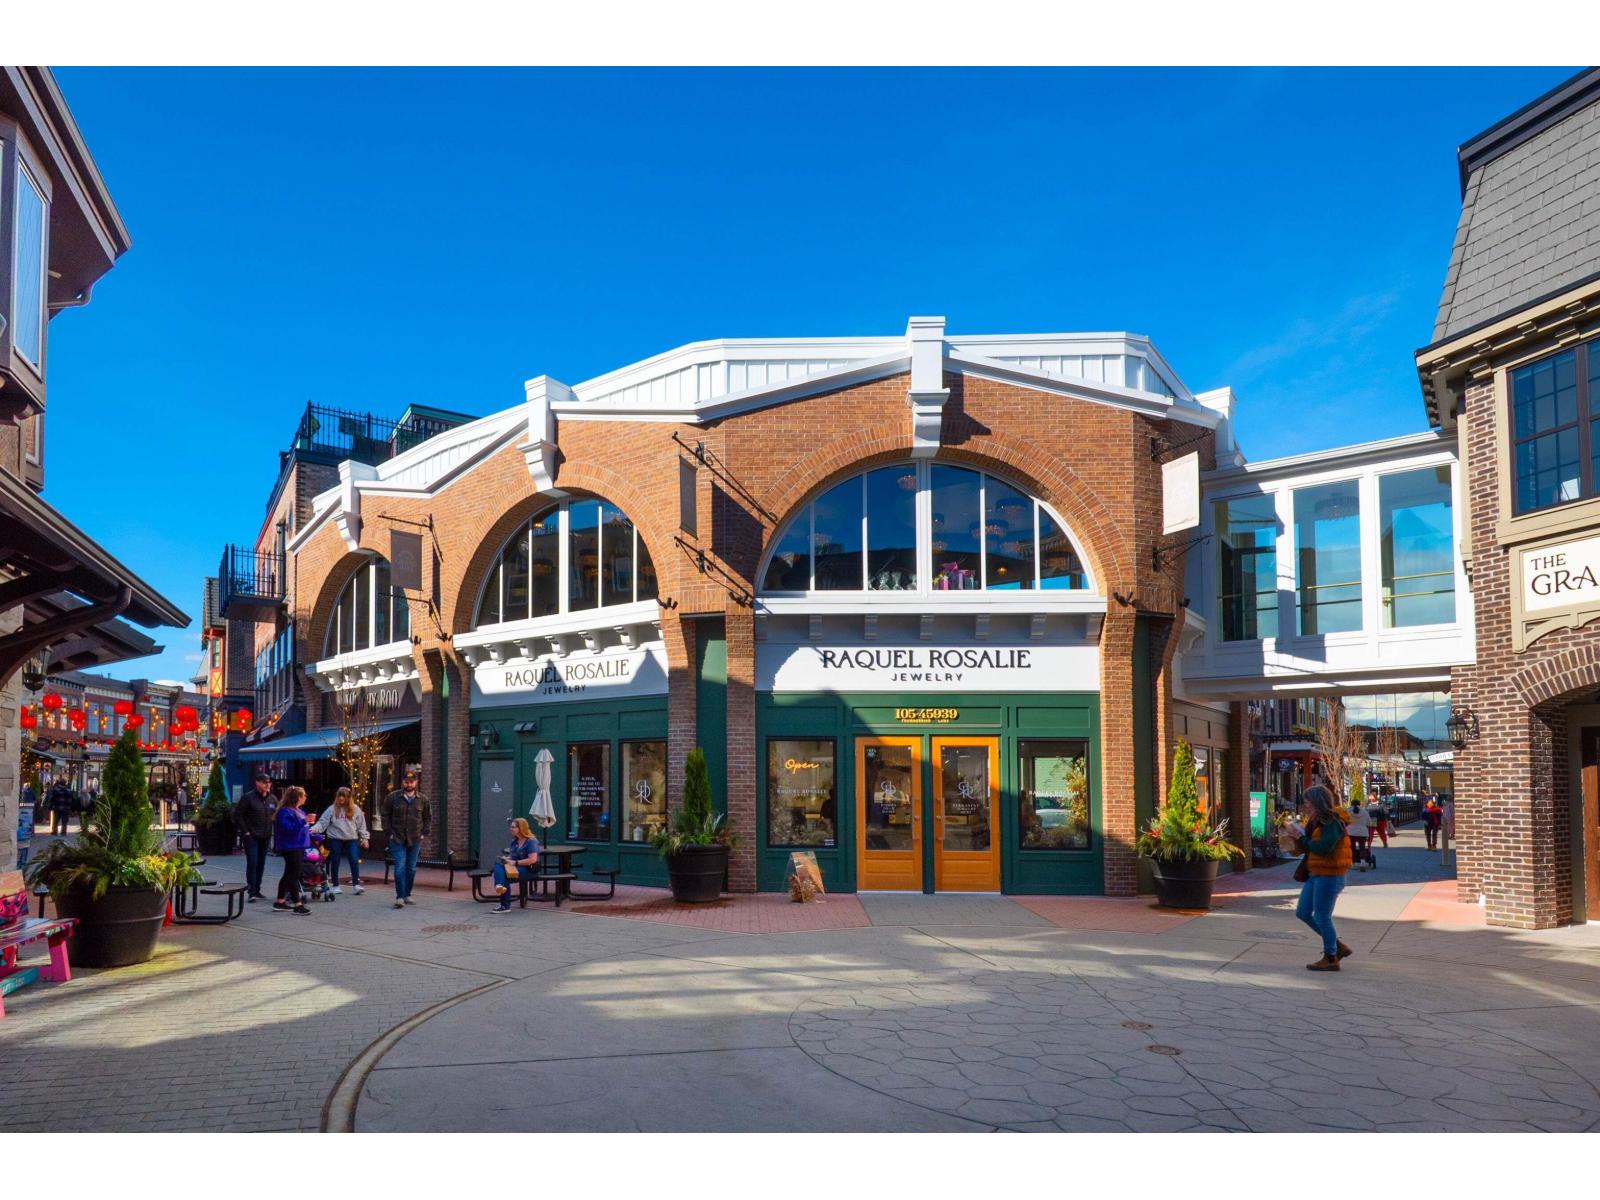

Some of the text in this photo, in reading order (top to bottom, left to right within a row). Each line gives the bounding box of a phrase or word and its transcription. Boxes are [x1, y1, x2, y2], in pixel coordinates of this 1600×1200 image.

[1531, 553, 1566, 570] THE
[822, 650, 1031, 670] RAQUEL ROSALIE
[505, 659, 629, 687] RAQUEL ROSALIE
[891, 673, 963, 681] JEWELRY
[543, 684, 586, 695] JEWELRY
[895, 708, 958, 719] 105-45939
[785, 759, 819, 774] Open
